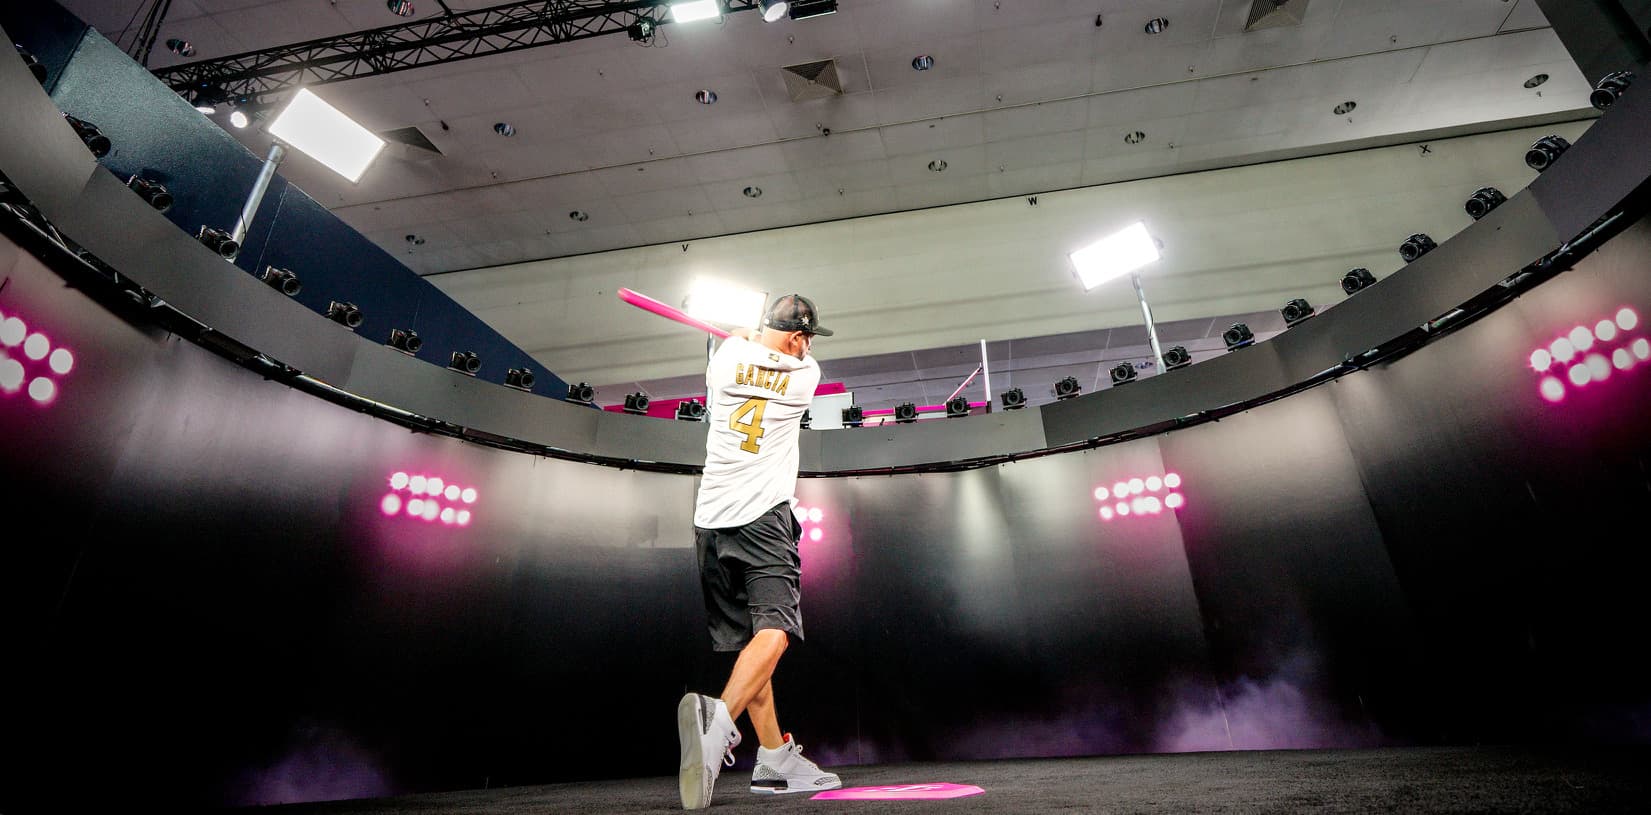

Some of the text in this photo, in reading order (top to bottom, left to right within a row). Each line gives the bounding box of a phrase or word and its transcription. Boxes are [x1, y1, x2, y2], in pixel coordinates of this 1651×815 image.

[1419, 144, 1431, 154] X
[1027, 196, 1038, 206] W
[681, 243, 689, 252] V
[729, 397, 768, 454] 4
